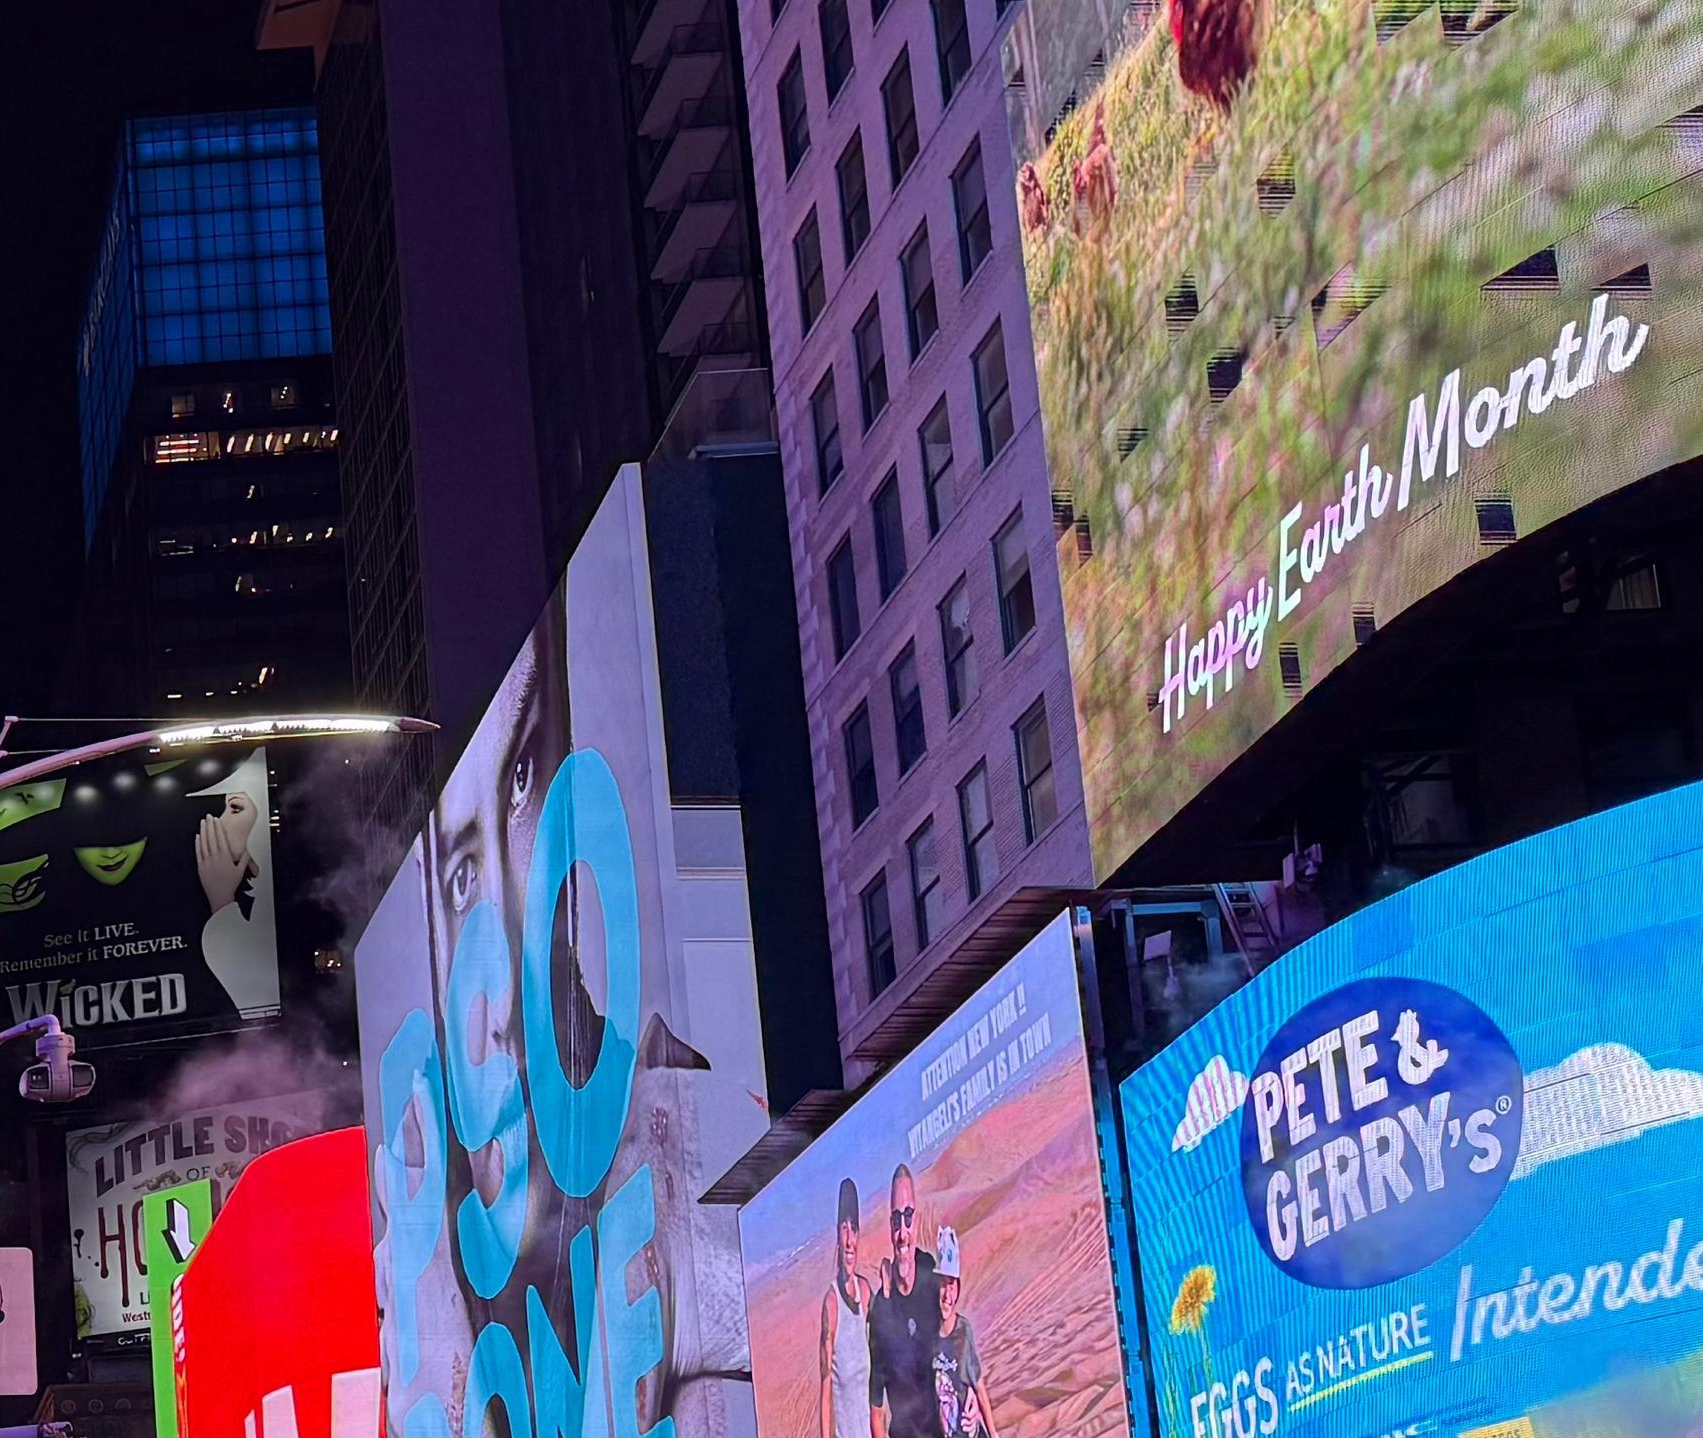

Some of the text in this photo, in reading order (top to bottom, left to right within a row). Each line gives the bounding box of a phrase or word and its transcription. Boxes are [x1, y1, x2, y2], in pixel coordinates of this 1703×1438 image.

[1157, 291, 1651, 734] Happy Earth Month
[0, 935, 188, 975] Remember it FOREVER.
[44, 921, 140, 949] See it LIVE.
[921, 1034, 969, 1102] ATTENTION
[966, 1014, 990, 1061] NEW
[990, 989, 1018, 1039] YORK
[960, 1059, 995, 1116] FAMILY
[995, 1051, 1009, 1085] IS
[1020, 1012, 1052, 1064] TOWN
[1252, 1009, 1389, 1164] PETE
[94, 1117, 215, 1198] LITTLE
[186, 1165, 212, 1181] OF
[1265, 1091, 1499, 1263] GERRY'S
[1285, 1358, 1315, 1402] AS
[1316, 1302, 1432, 1391] NATURE
